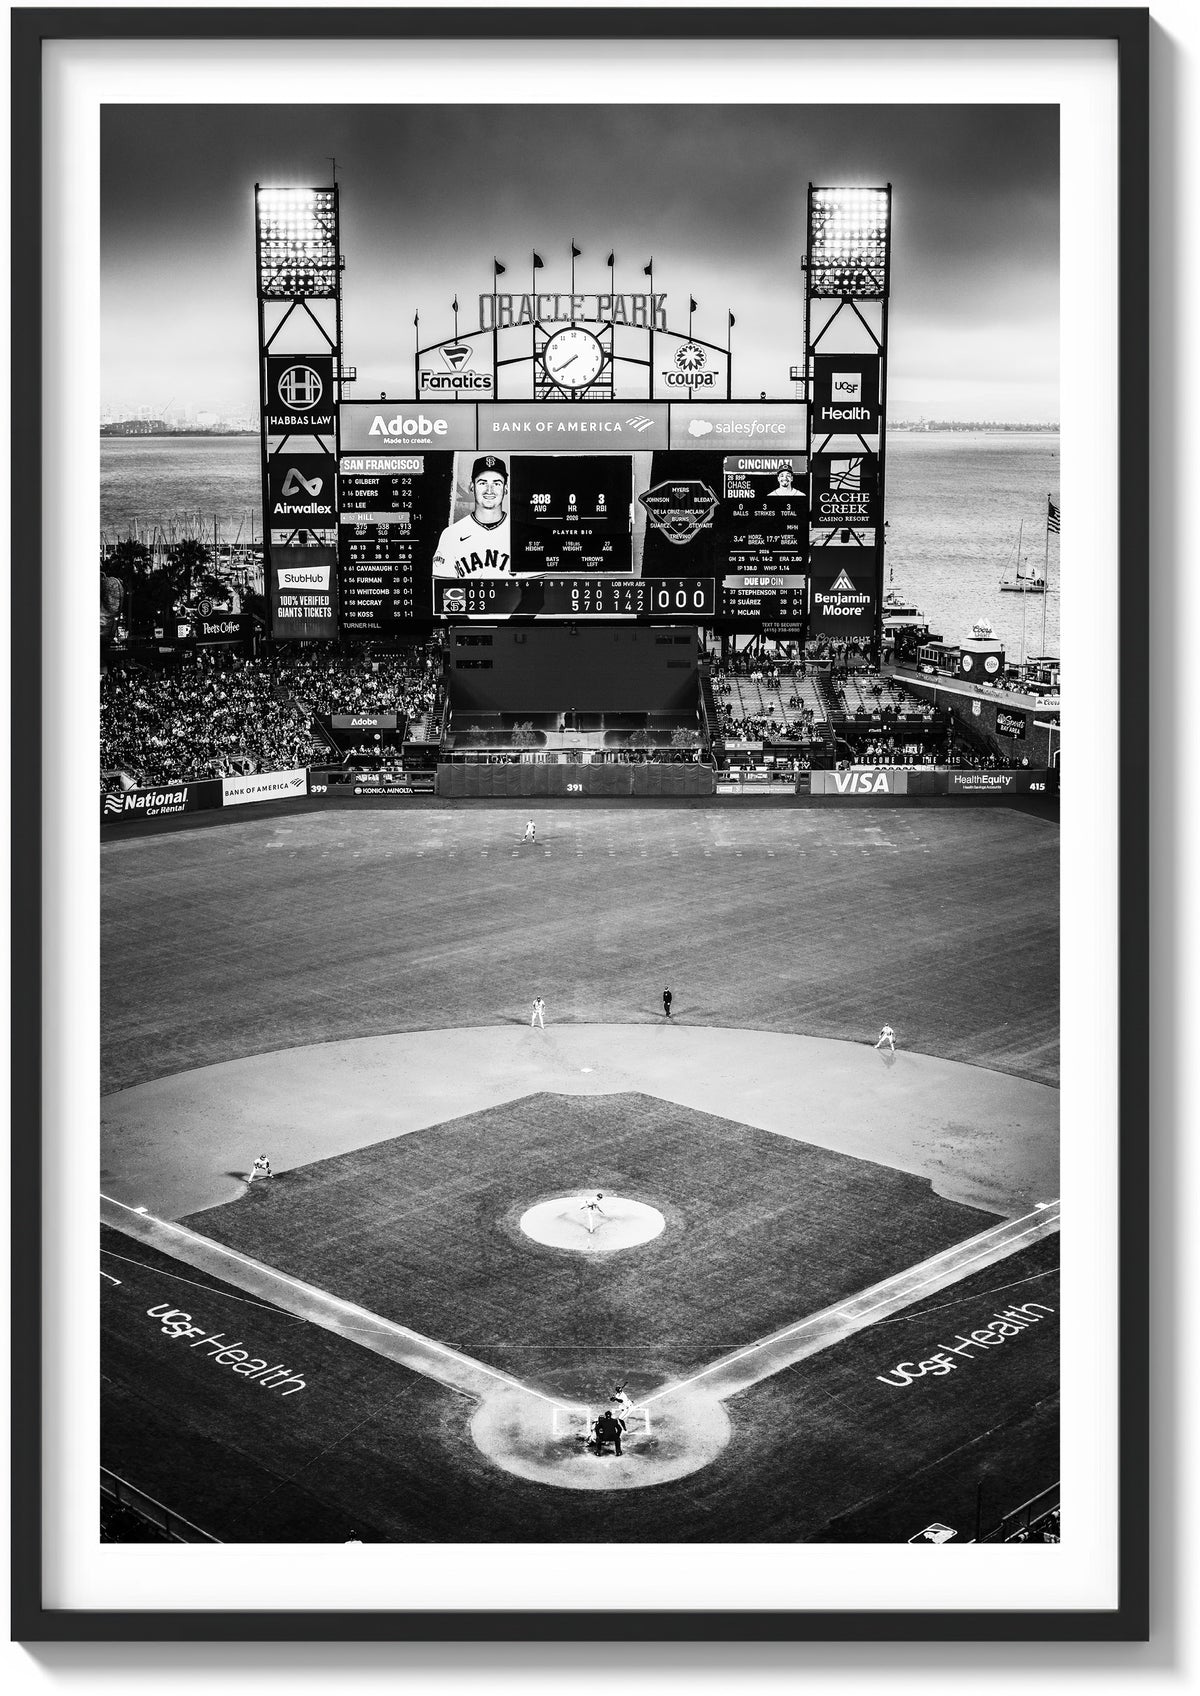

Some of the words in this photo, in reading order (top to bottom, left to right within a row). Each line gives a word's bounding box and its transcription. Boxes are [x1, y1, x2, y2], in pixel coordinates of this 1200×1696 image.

[479, 294, 585, 332] ORACLE
[596, 293, 668, 332] PARK
[421, 372, 492, 388] Fanatics
[668, 372, 713, 388] coupa
[835, 381, 858, 393] UCSF
[822, 407, 870, 420] Health
[270, 416, 308, 424] HABBAS
[311, 416, 331, 424] LAW
[368, 415, 448, 435] Adobe
[493, 422, 531, 432] BANK
[536, 422, 554, 432] OF
[557, 422, 622, 432] AMERICA
[715, 420, 786, 437] salesforce
[344, 459, 363, 470] SAN
[365, 459, 419, 470] FRANCISCO
[738, 459, 792, 469] CINCINNATI
[530, 494, 551, 504] .308
[569, 494, 576, 504] 0
[598, 494, 605, 504] 3
[728, 490, 755, 498] BURNS
[820, 493, 870, 502] CACHE
[274, 503, 332, 514] Airwallex
[821, 504, 868, 514] CREEK
[455, 549, 516, 578] GIANT
[284, 574, 323, 583] StubHub
[469, 590, 475, 598] 0
[479, 590, 485, 598] 0
[489, 590, 495, 598] 0
[572, 589, 579, 599] 0
[584, 590, 590, 598] 2
[596, 590, 602, 598] 0
[614, 590, 620, 598] 3
[625, 590, 632, 598] 4
[637, 590, 643, 598] 2
[658, 590, 669, 607] 0
[676, 590, 686, 607] 0
[693, 590, 704, 607] 0
[815, 593, 870, 605] Benjamin
[280, 595, 298, 605] 100%
[300, 595, 329, 605] VERIFIED
[469, 601, 475, 610] 2
[479, 601, 485, 610] 3
[572, 601, 579, 611] 5
[584, 601, 590, 610] 7
[596, 601, 602, 610] 0
[614, 601, 618, 610] 1
[625, 601, 632, 610] 4
[637, 601, 643, 610] 2
[278, 607, 302, 617] GIANTS
[304, 607, 331, 617] TICKETS
[220, 621, 240, 633] Coffee
[1005, 716, 1025, 728] Sports
[830, 773, 890, 792] VISA
[954, 775, 1012, 785] HealthEquity
[257, 783, 289, 793] AMERICA
[566, 784, 583, 792] 391
[124, 788, 188, 810] National
[146, 807, 159, 816] Car
[161, 804, 184, 814] Rental
[147, 1304, 206, 1340] UCSF
[190, 1333, 306, 1396] Health
[876, 1352, 958, 1388] UCSF
[937, 1303, 1055, 1358] Health
